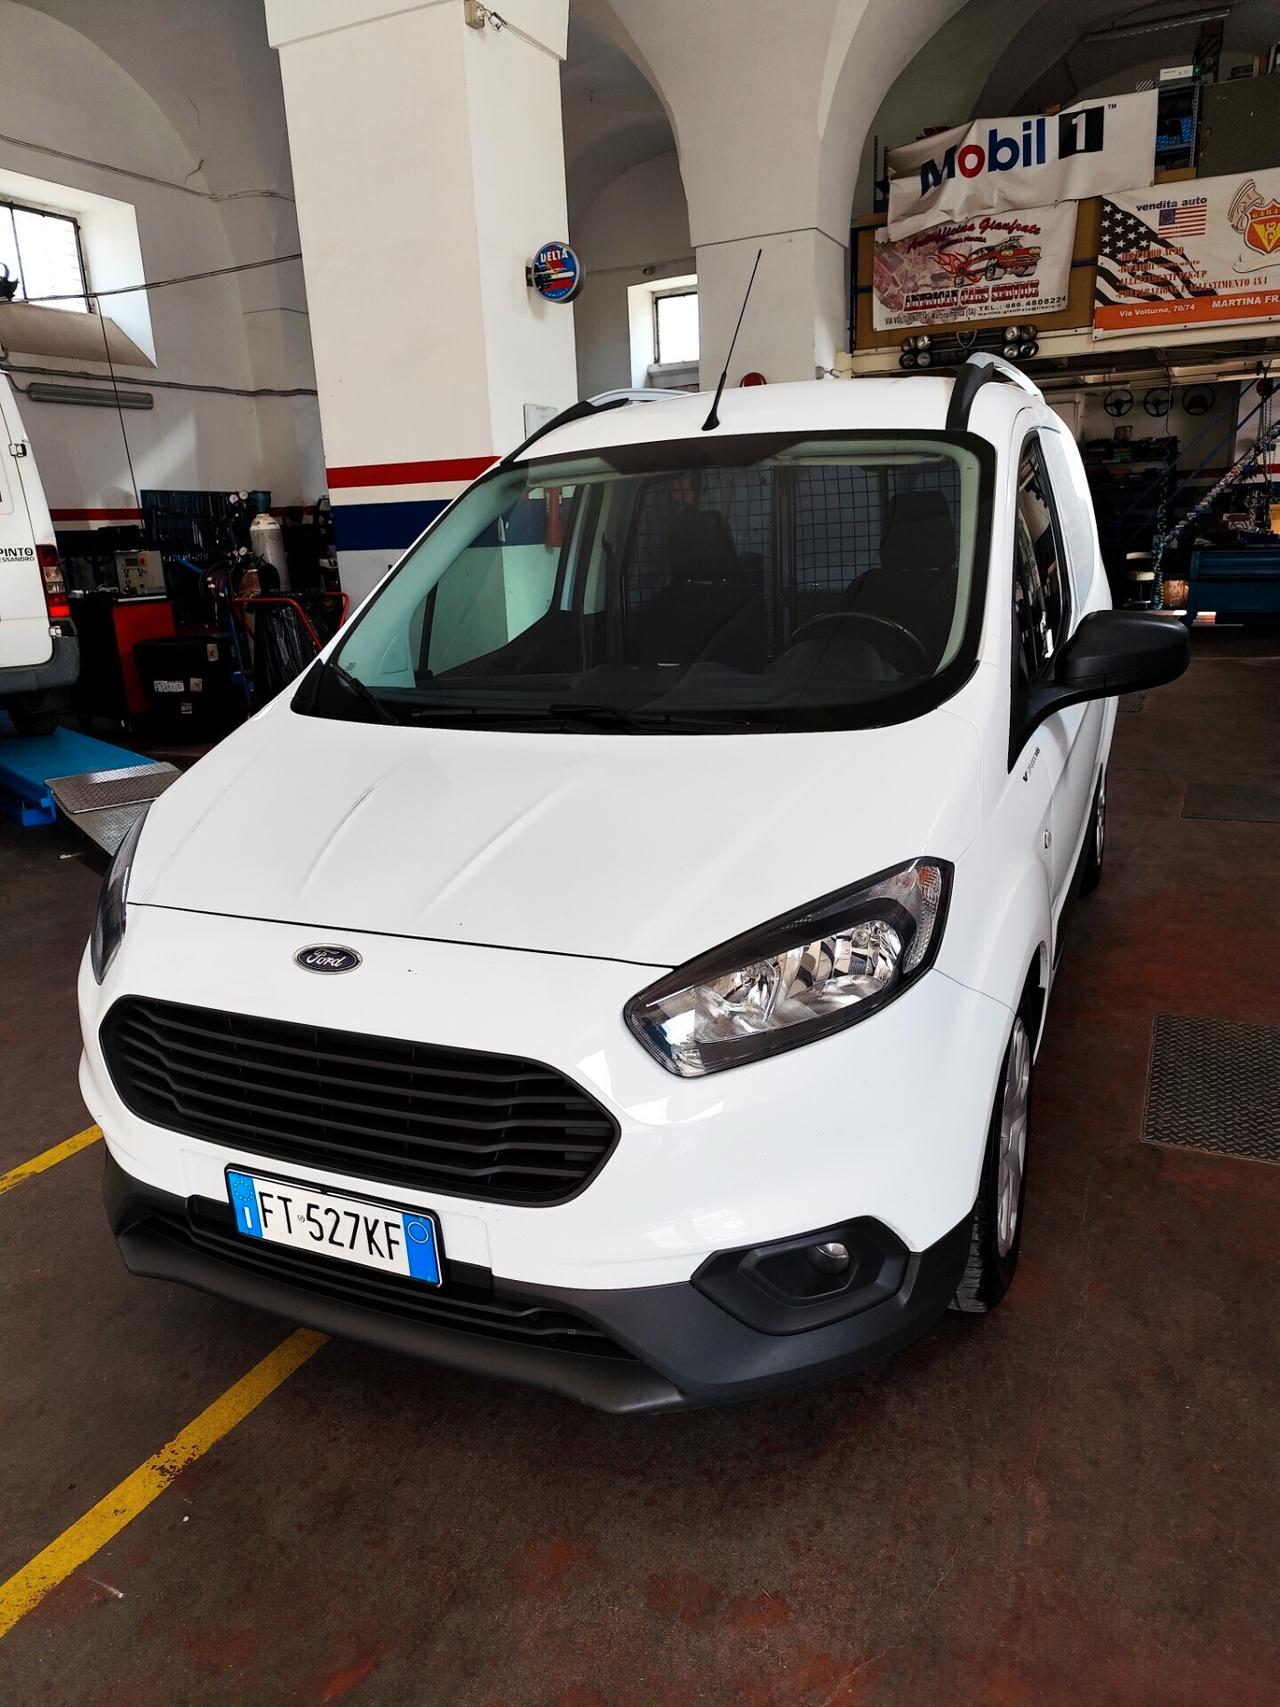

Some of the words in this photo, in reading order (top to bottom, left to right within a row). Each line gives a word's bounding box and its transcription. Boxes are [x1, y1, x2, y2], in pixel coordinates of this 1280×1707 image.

[920, 117, 1046, 199] Mobil
[1136, 200, 1178, 212] vendita
[1181, 196, 1208, 206] auto
[540, 247, 569, 263] DELTA
[904, 289, 959, 312] AMERICAN
[960, 284, 990, 305] CARS
[991, 279, 1040, 302] SERVICE
[1119, 310, 1133, 318] Via
[1135, 306, 1172, 317] Volturno,
[1211, 297, 1262, 309] MARTINA
[1264, 294, 1280, 304] FR
[306, 948, 347, 967] Ford
[258, 1191, 292, 1234] FT
[306, 1203, 401, 1261] 527KF
